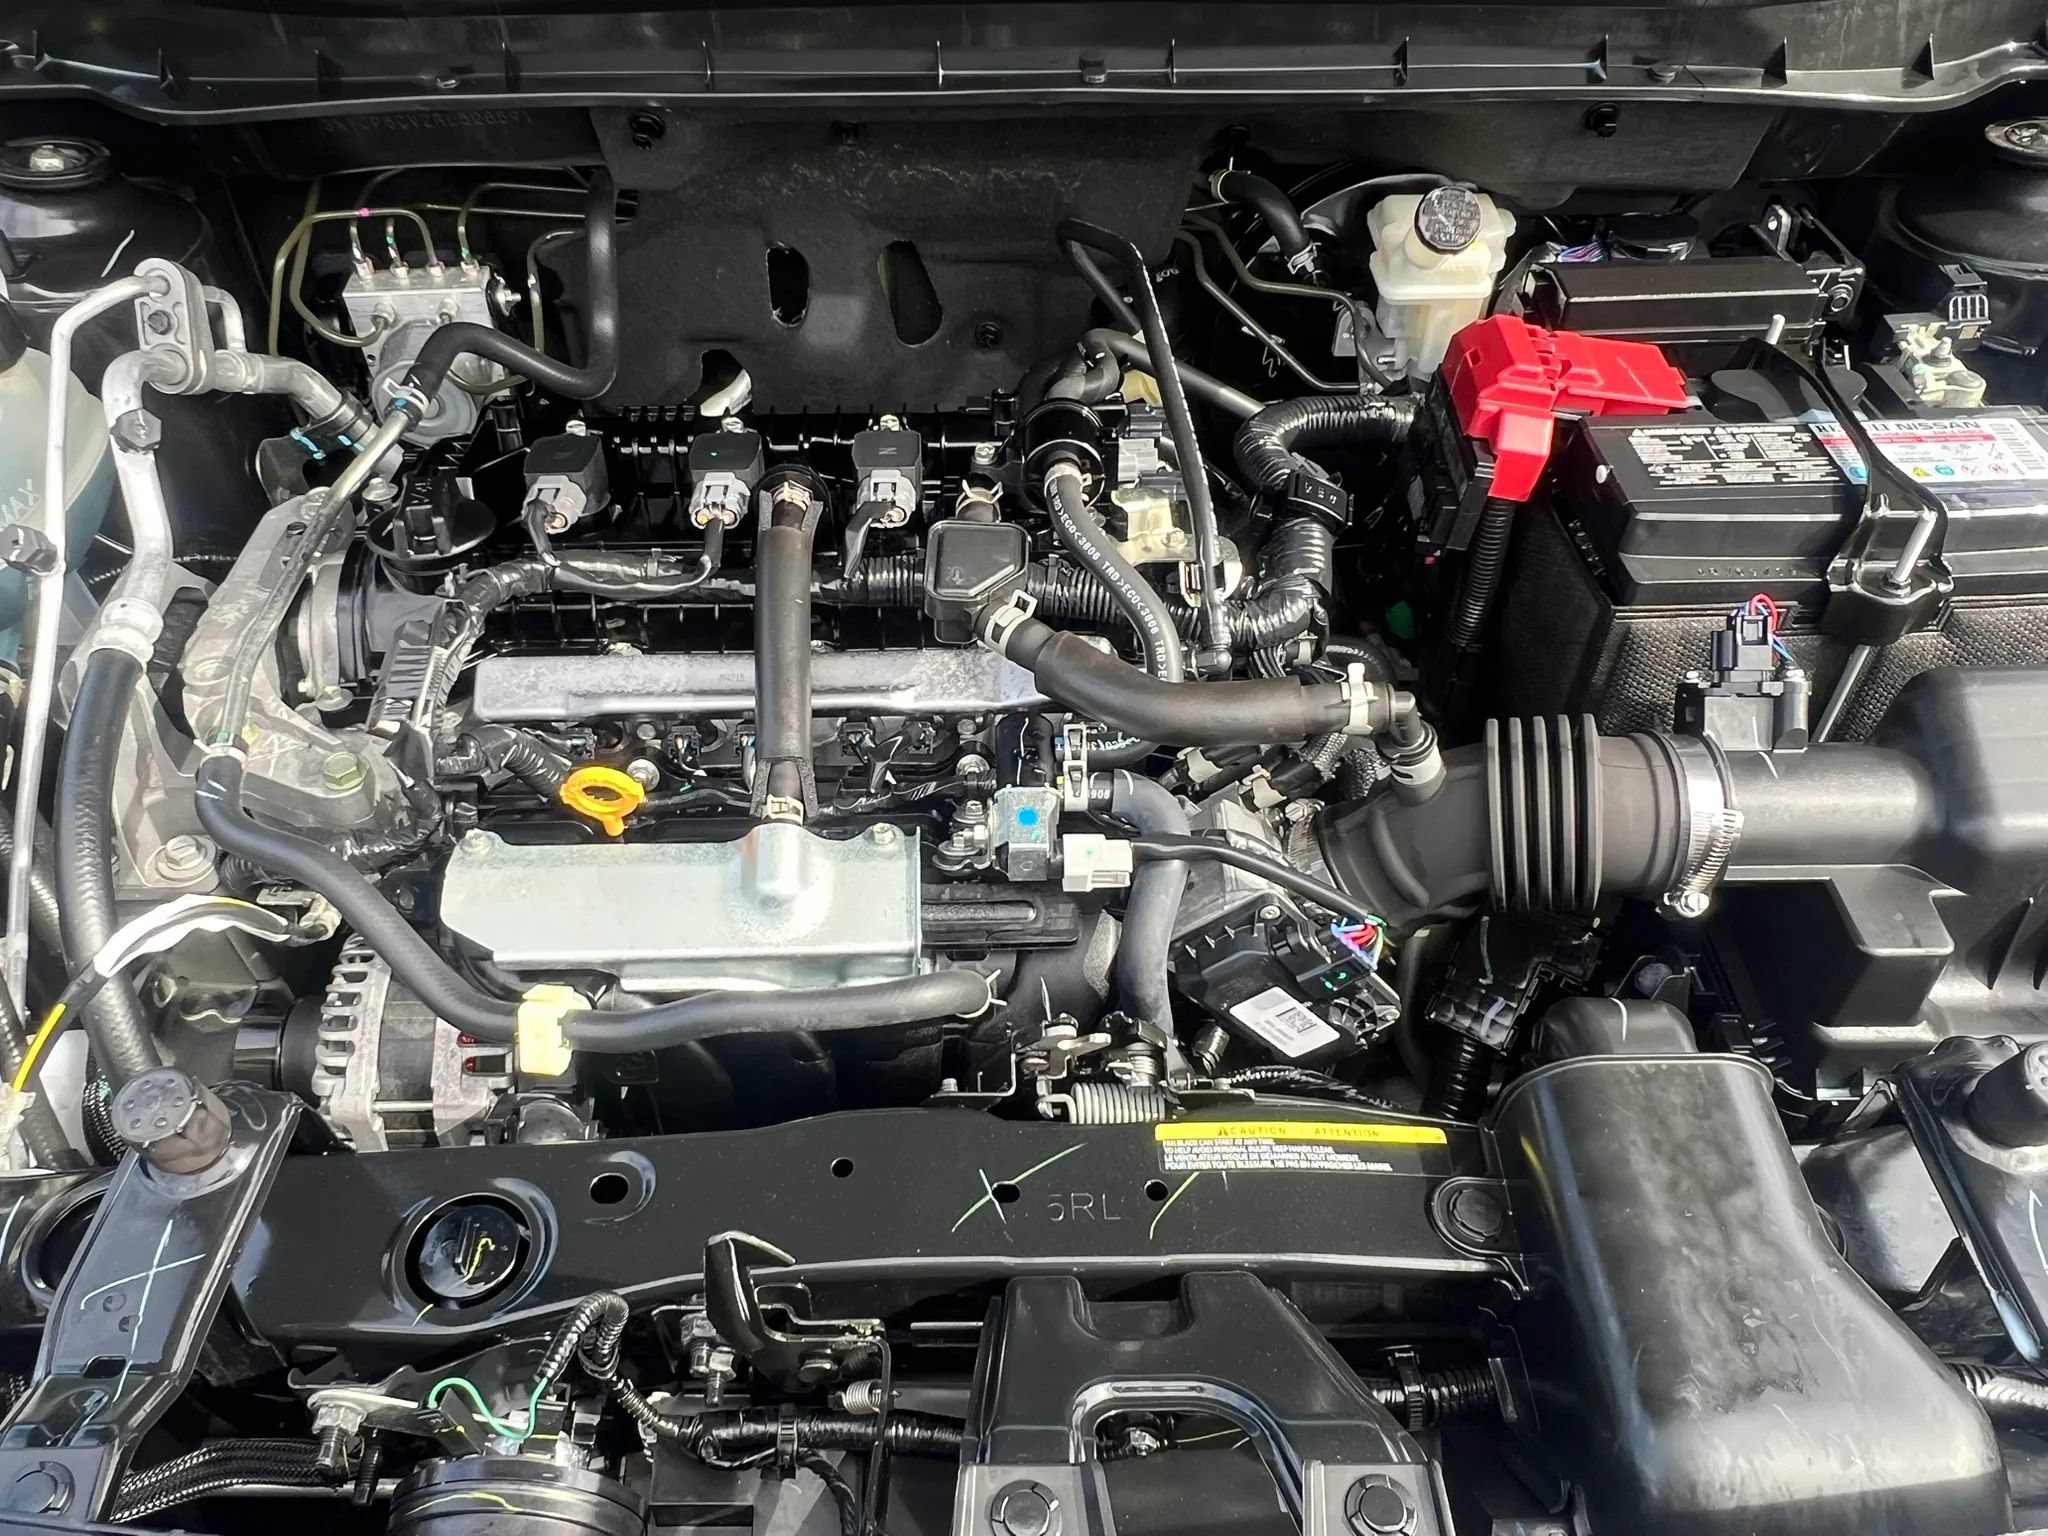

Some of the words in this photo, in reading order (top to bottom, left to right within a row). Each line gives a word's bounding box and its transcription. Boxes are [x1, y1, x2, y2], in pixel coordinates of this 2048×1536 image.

[1897, 421, 1982, 431] NISSAN
[1231, 1126, 1287, 1135] CAUTION
[1314, 1127, 1380, 1137] ATTENTION
[1047, 1192, 1122, 1222] 5RL
